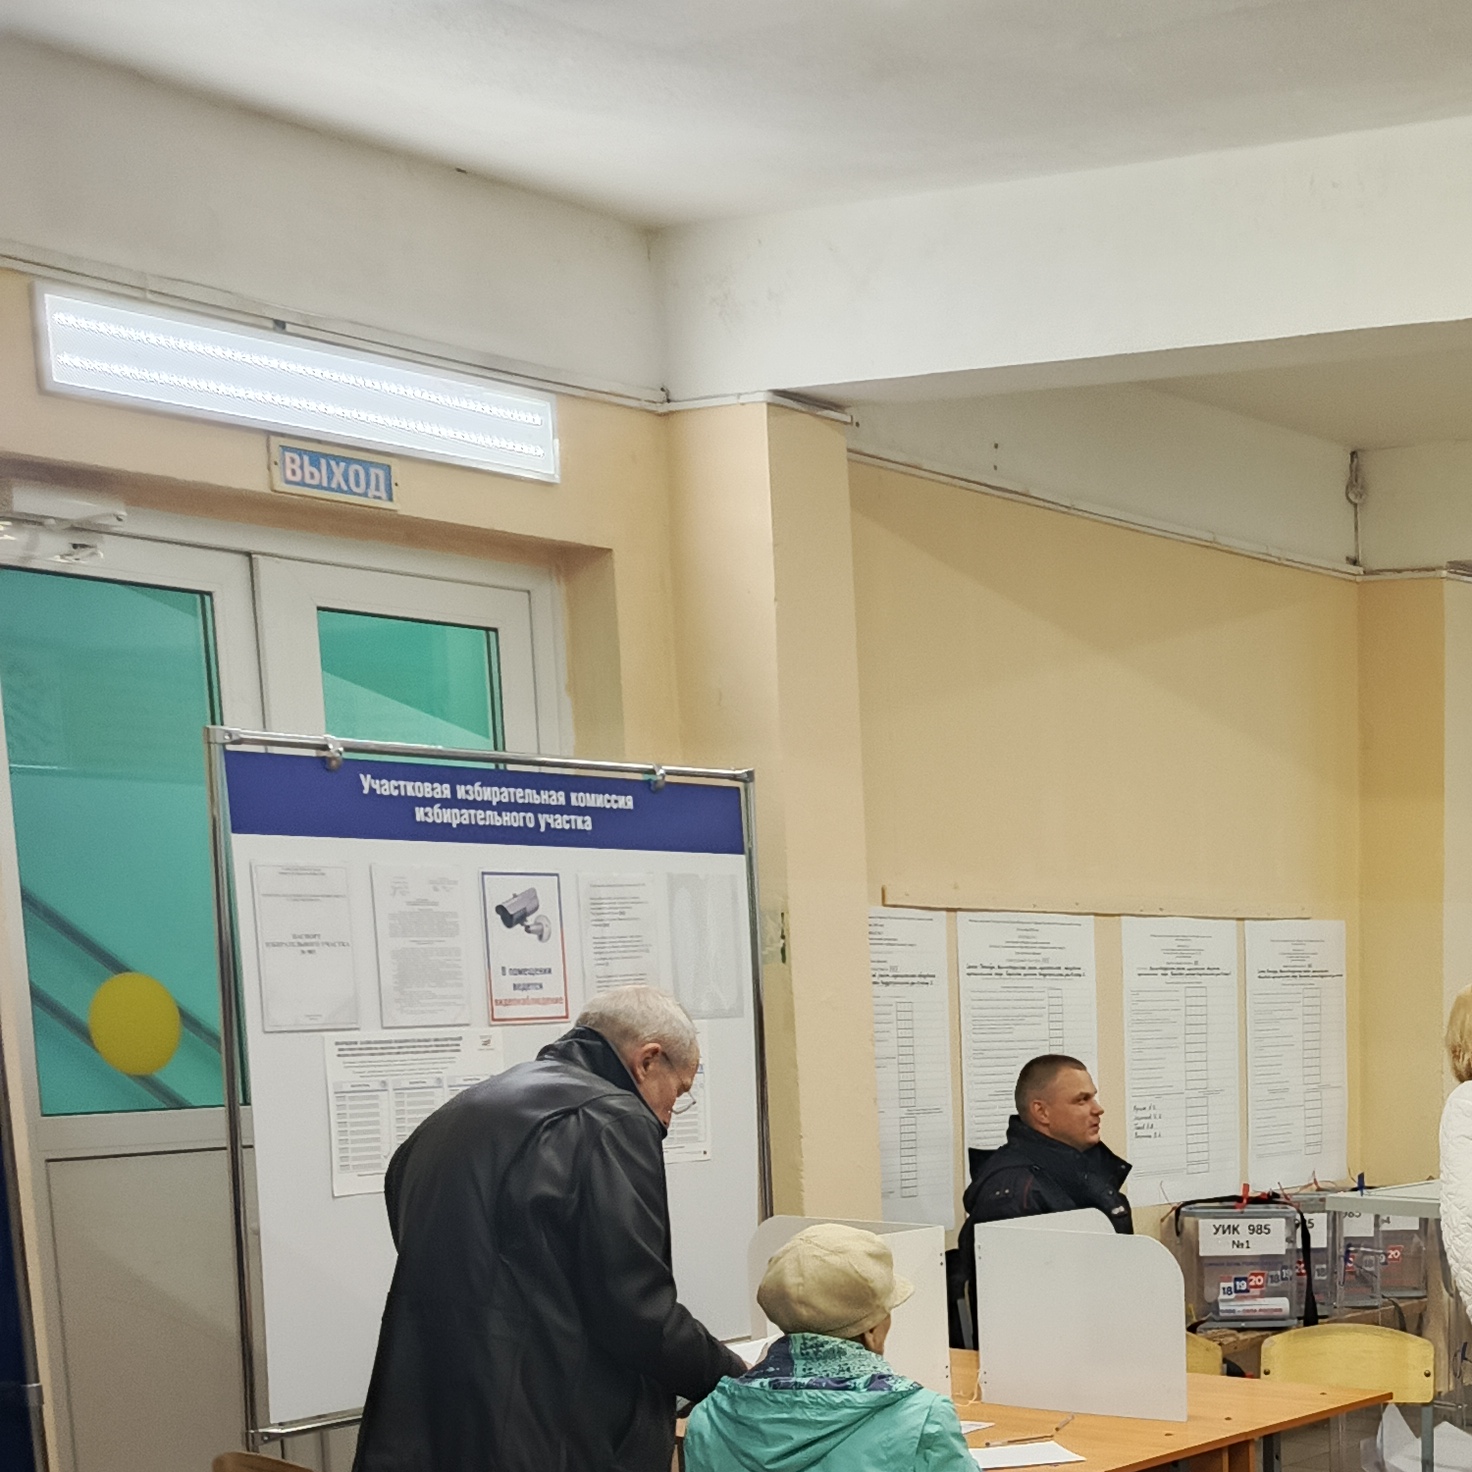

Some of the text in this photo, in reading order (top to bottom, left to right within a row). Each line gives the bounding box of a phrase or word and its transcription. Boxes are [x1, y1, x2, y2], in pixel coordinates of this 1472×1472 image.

[284, 451, 388, 501] ВЫХОД
[359, 773, 634, 810] Участковая избирательная комиссия
[415, 803, 593, 832] избирательного участка
[1212, 1223, 1271, 1235] УИК 985
[1231, 1239, 1251, 1249] №1
[1388, 1251, 1400, 1259] 20
[1222, 1275, 1264, 1295] 18 19 20
